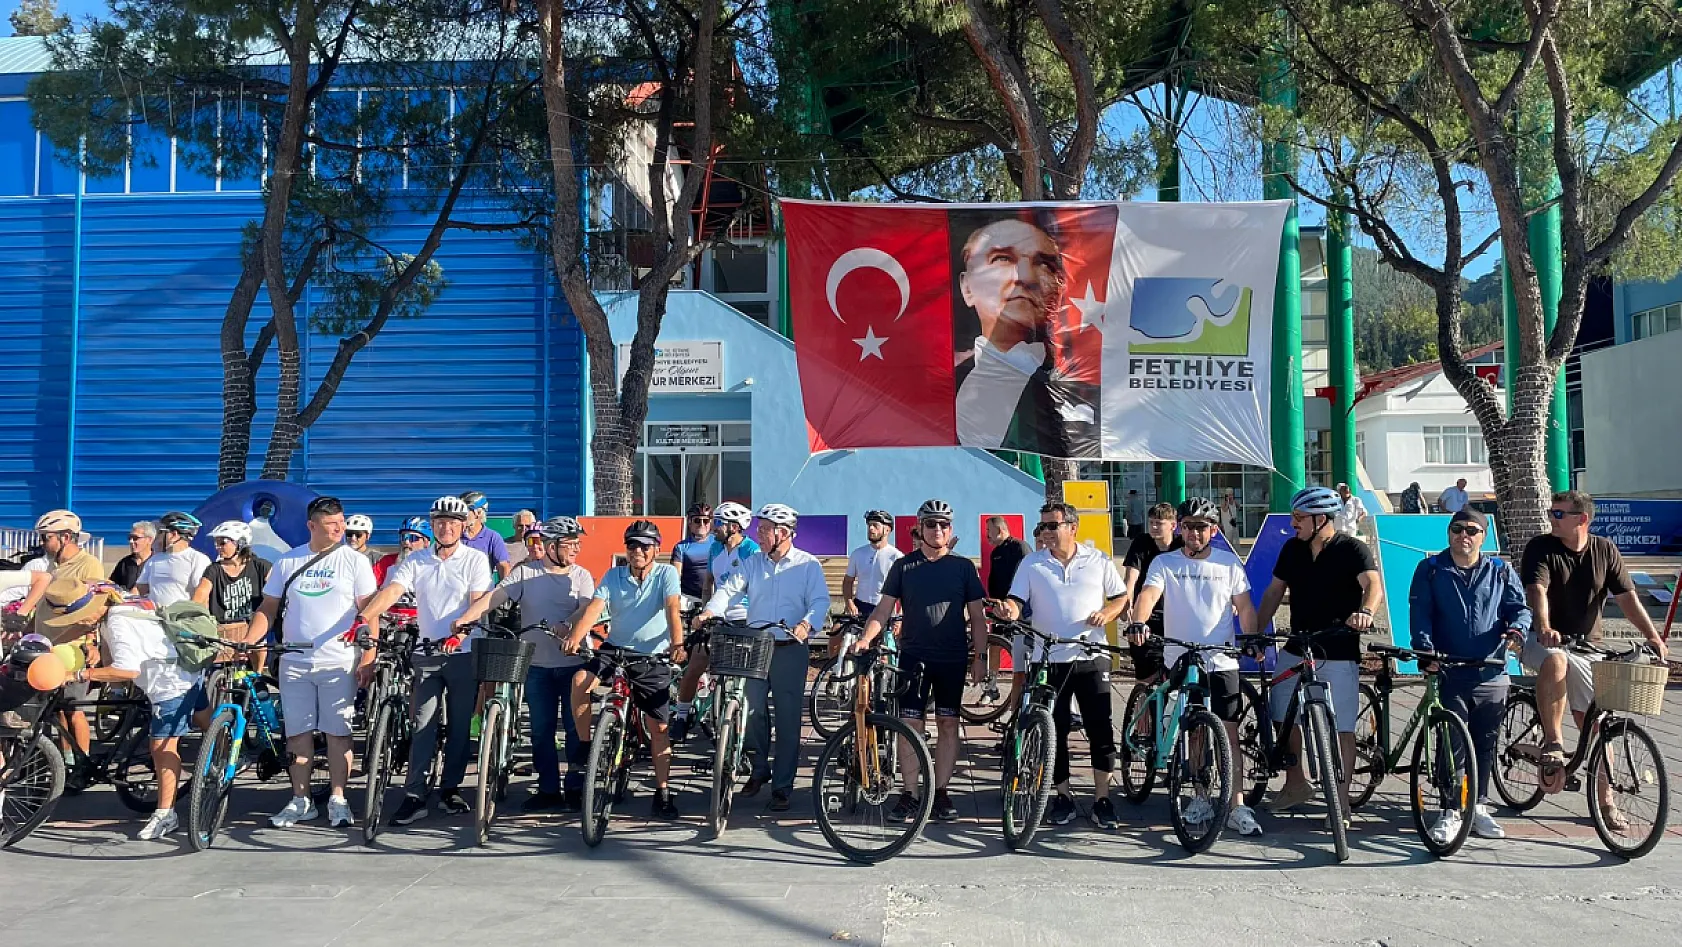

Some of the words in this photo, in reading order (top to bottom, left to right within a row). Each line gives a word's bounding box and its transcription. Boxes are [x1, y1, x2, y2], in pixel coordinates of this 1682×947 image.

[1128, 356, 1254, 377] FETHİYE
[668, 375, 715, 386] MERKEZİ
[1128, 377, 1254, 391] BELEDİYESİ
